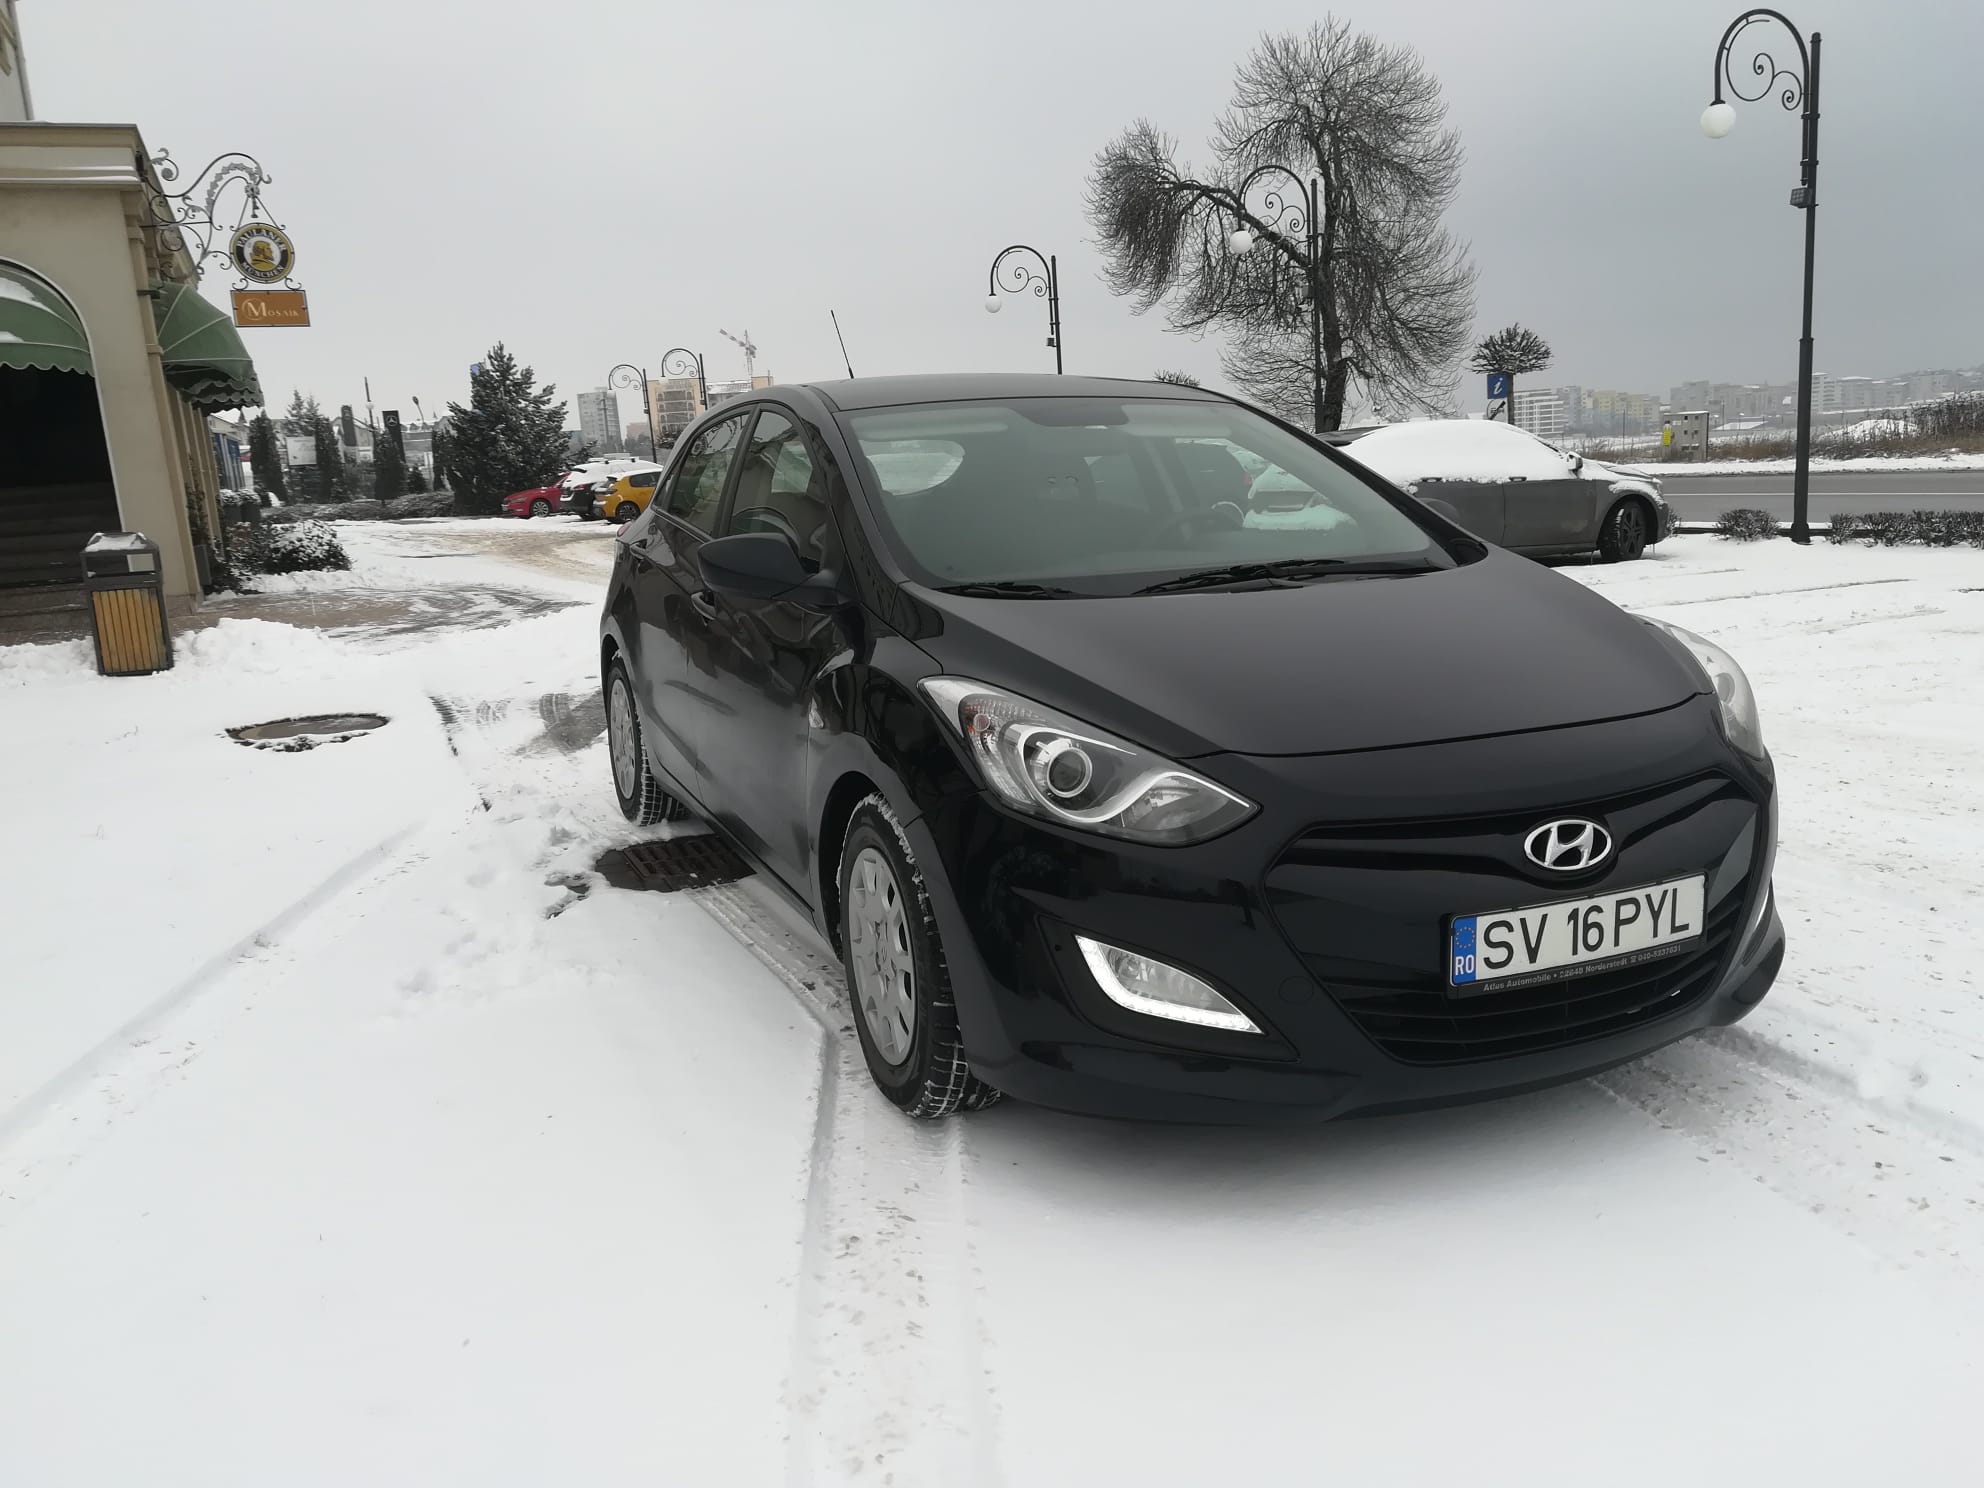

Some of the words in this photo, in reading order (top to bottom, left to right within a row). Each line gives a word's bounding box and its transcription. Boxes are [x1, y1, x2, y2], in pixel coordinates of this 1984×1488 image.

[237, 229, 287, 251] PAULANER
[1483, 913, 1548, 970] SV
[1567, 904, 1605, 956] 16
[1613, 888, 1690, 948] PYL
[1455, 955, 1475, 976] RO
